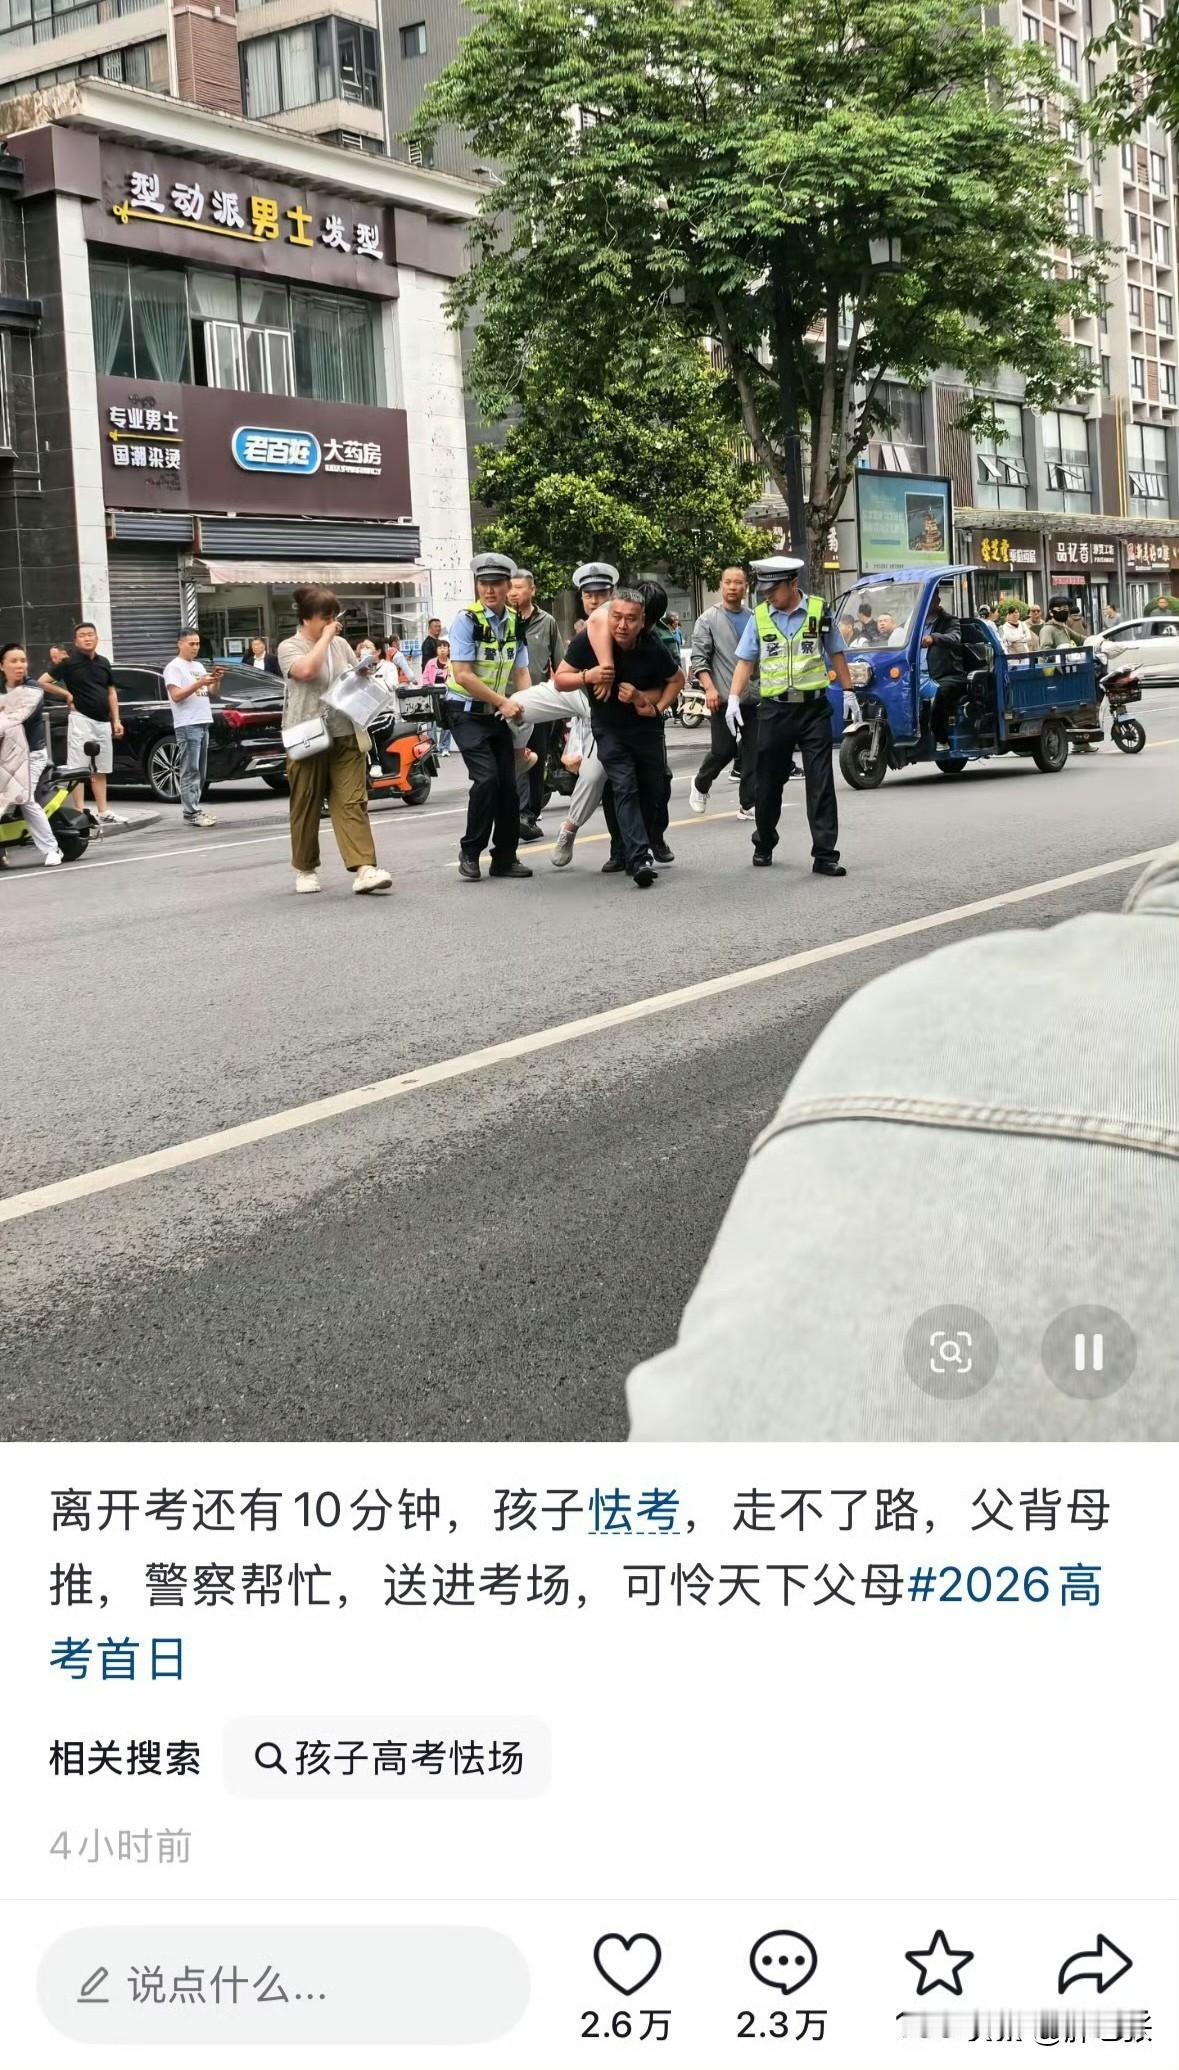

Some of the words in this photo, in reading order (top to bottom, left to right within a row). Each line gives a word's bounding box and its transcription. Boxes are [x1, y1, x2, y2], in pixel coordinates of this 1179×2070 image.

[130, 171, 384, 260] 型动派男士发型
[109, 406, 179, 432] 专业男士
[112, 444, 181, 470] 国潮染烫
[323, 438, 382, 465] 大药房
[1055, 542, 1089, 564] 品忆香
